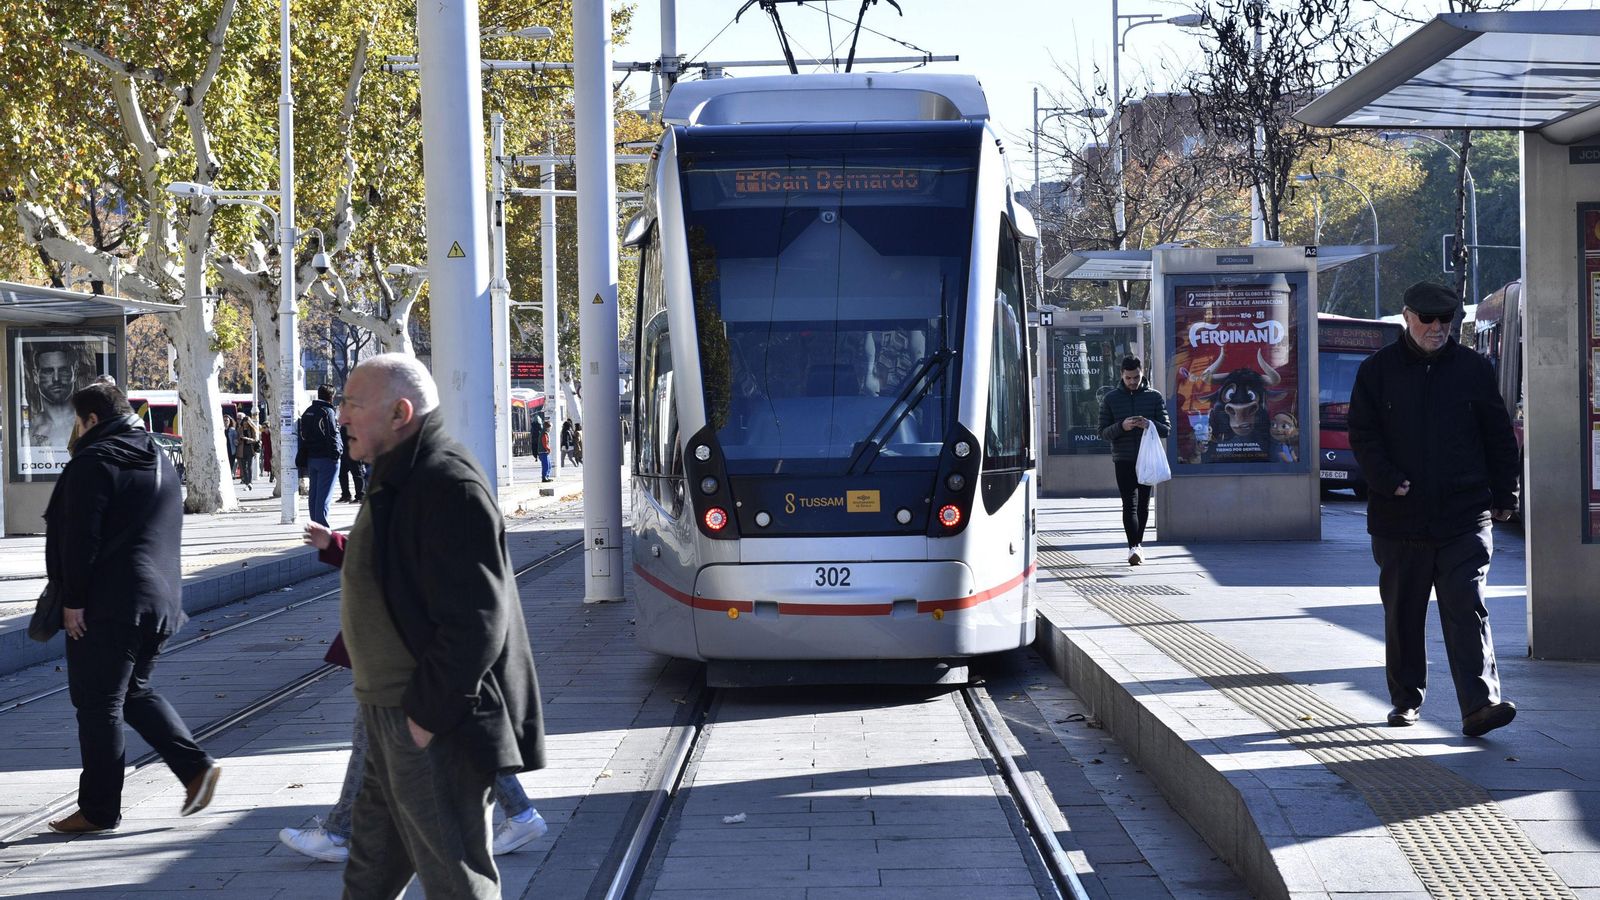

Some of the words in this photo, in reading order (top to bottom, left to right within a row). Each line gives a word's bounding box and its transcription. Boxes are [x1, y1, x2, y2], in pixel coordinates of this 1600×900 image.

[1305, 248, 1317, 256] A2
[1188, 293, 1195, 307] 2
[1041, 314, 1052, 325] H
[1188, 320, 1285, 348] FERDINAND
[21, 462, 53, 471] paco
[799, 497, 844, 507] TUSSAM
[815, 567, 851, 587] 302
